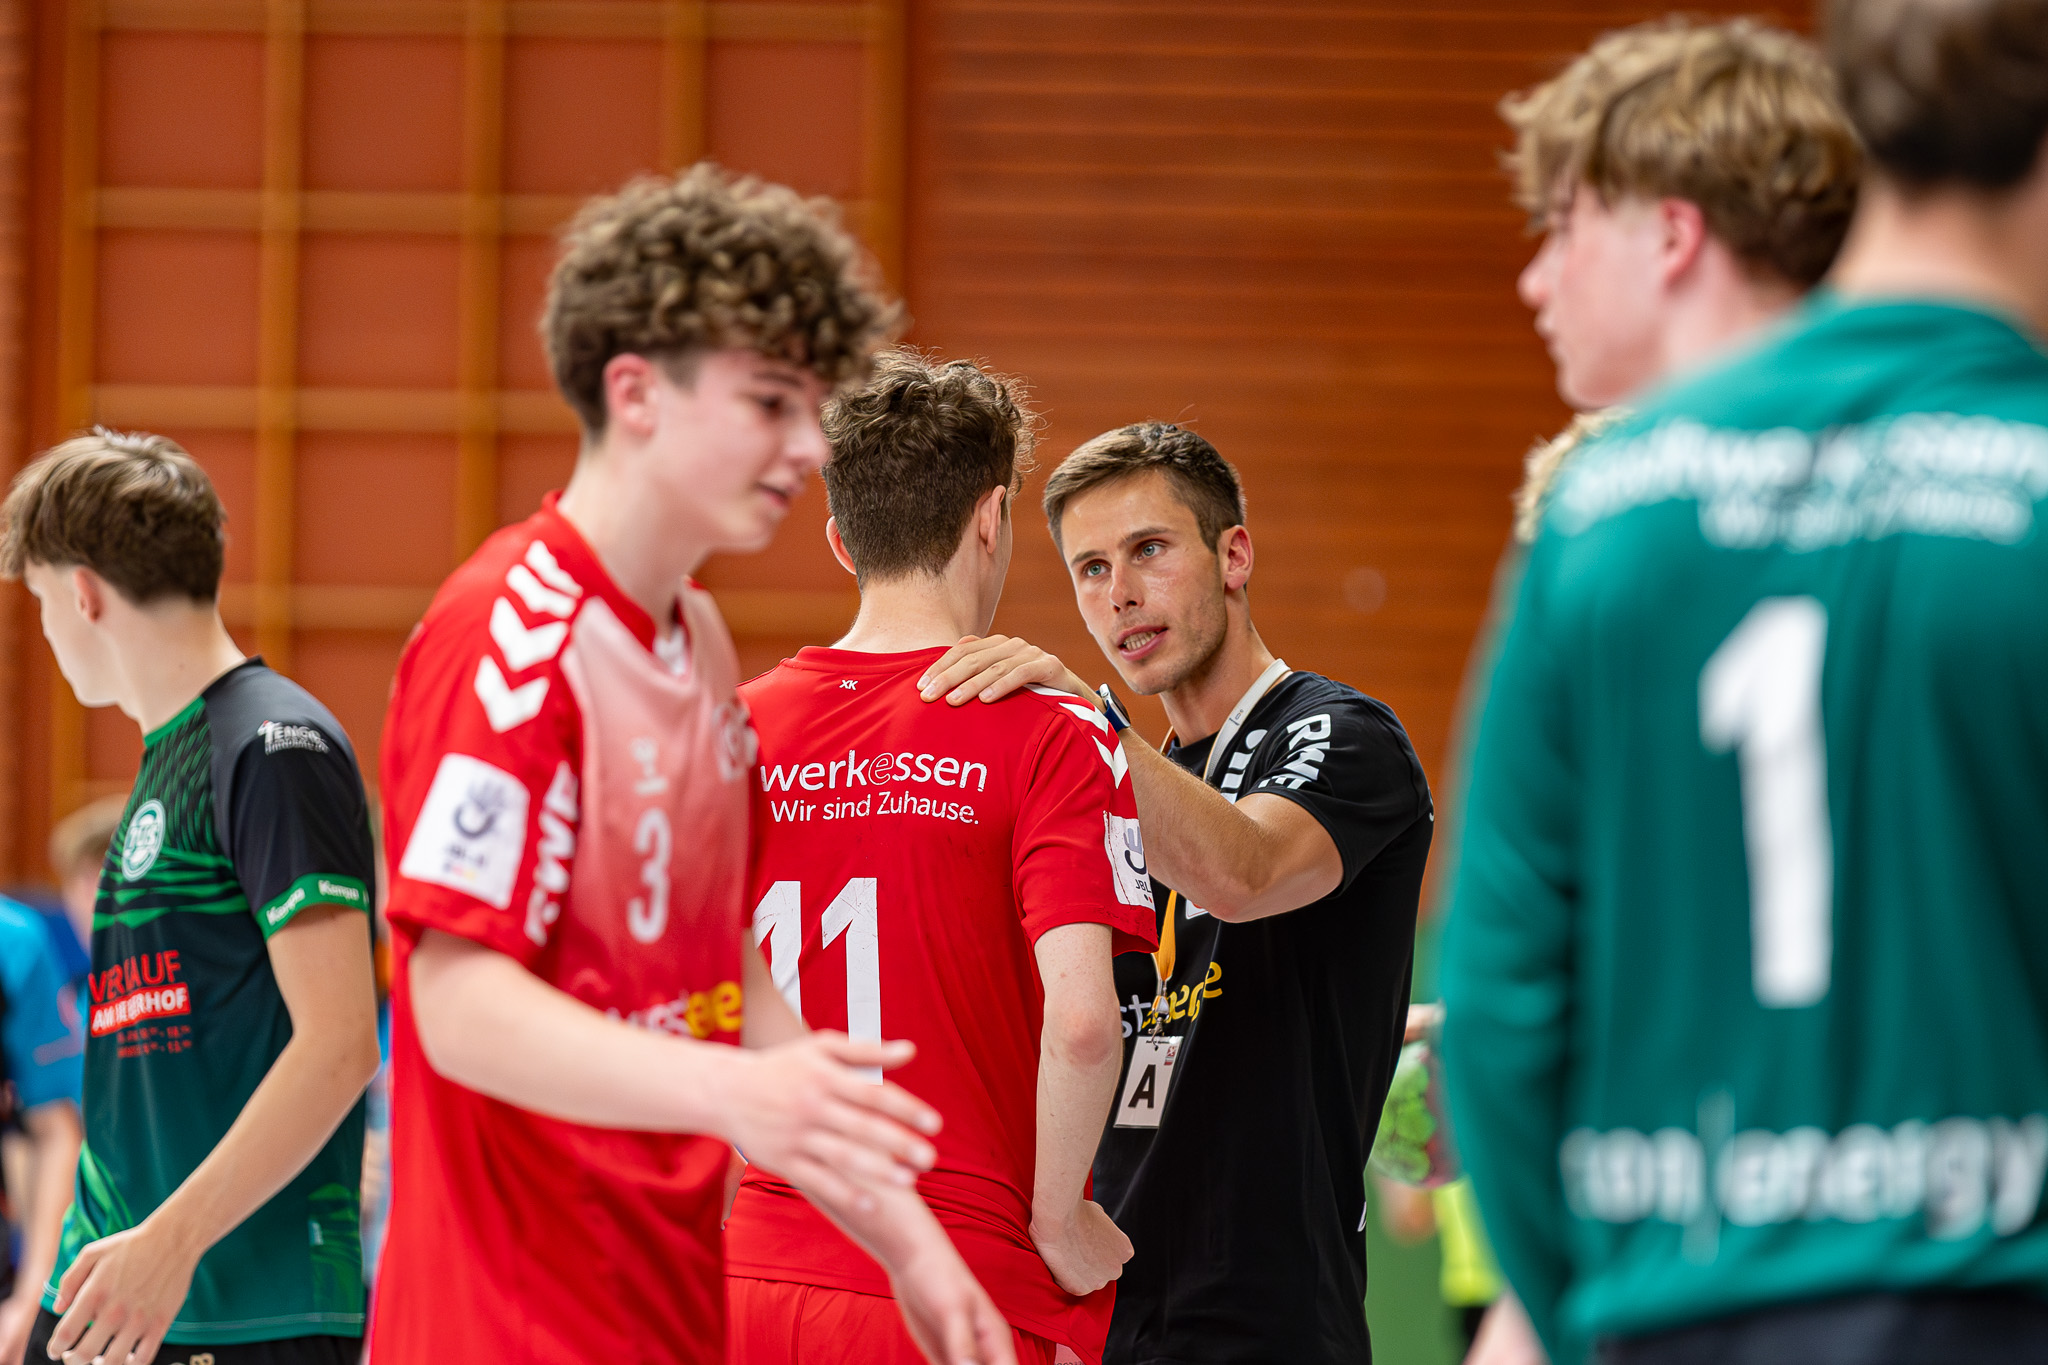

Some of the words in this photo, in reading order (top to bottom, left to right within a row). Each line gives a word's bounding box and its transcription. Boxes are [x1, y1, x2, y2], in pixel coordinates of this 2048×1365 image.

[760, 749, 987, 792] werkessen
[771, 799, 816, 823] Wir
[823, 794, 871, 820] sind
[877, 790, 979, 825] Zuhause.
[1698, 596, 1834, 1007] 1
[626, 808, 672, 944] 3
[752, 877, 883, 1086] 11
[1127, 1063, 1156, 1109] A
